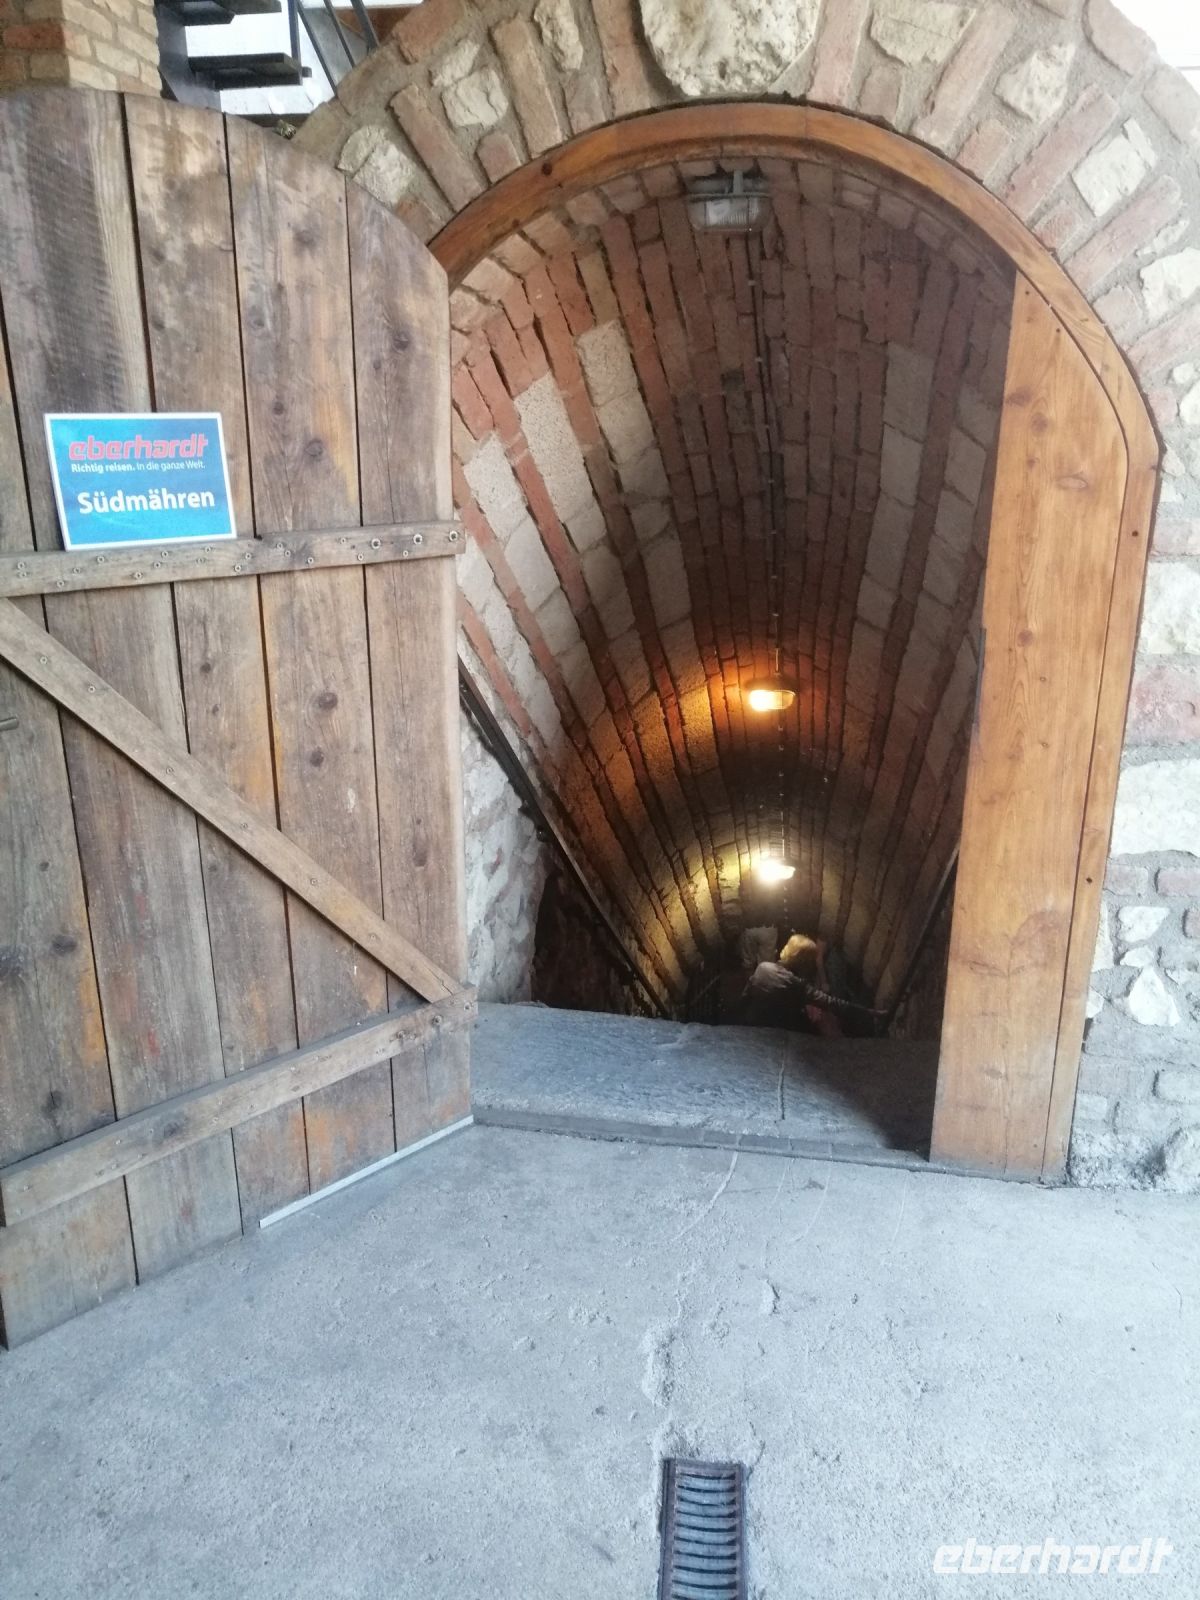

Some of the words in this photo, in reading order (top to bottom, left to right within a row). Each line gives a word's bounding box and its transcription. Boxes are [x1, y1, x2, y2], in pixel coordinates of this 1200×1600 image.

[69, 433, 208, 460] eberhardt
[71, 462, 104, 474] Richtig
[105, 462, 135, 472] reisen.
[146, 461, 159, 470] die
[161, 462, 184, 472] ganze
[185, 460, 206, 469] Welt.
[77, 488, 215, 514] Südmähren
